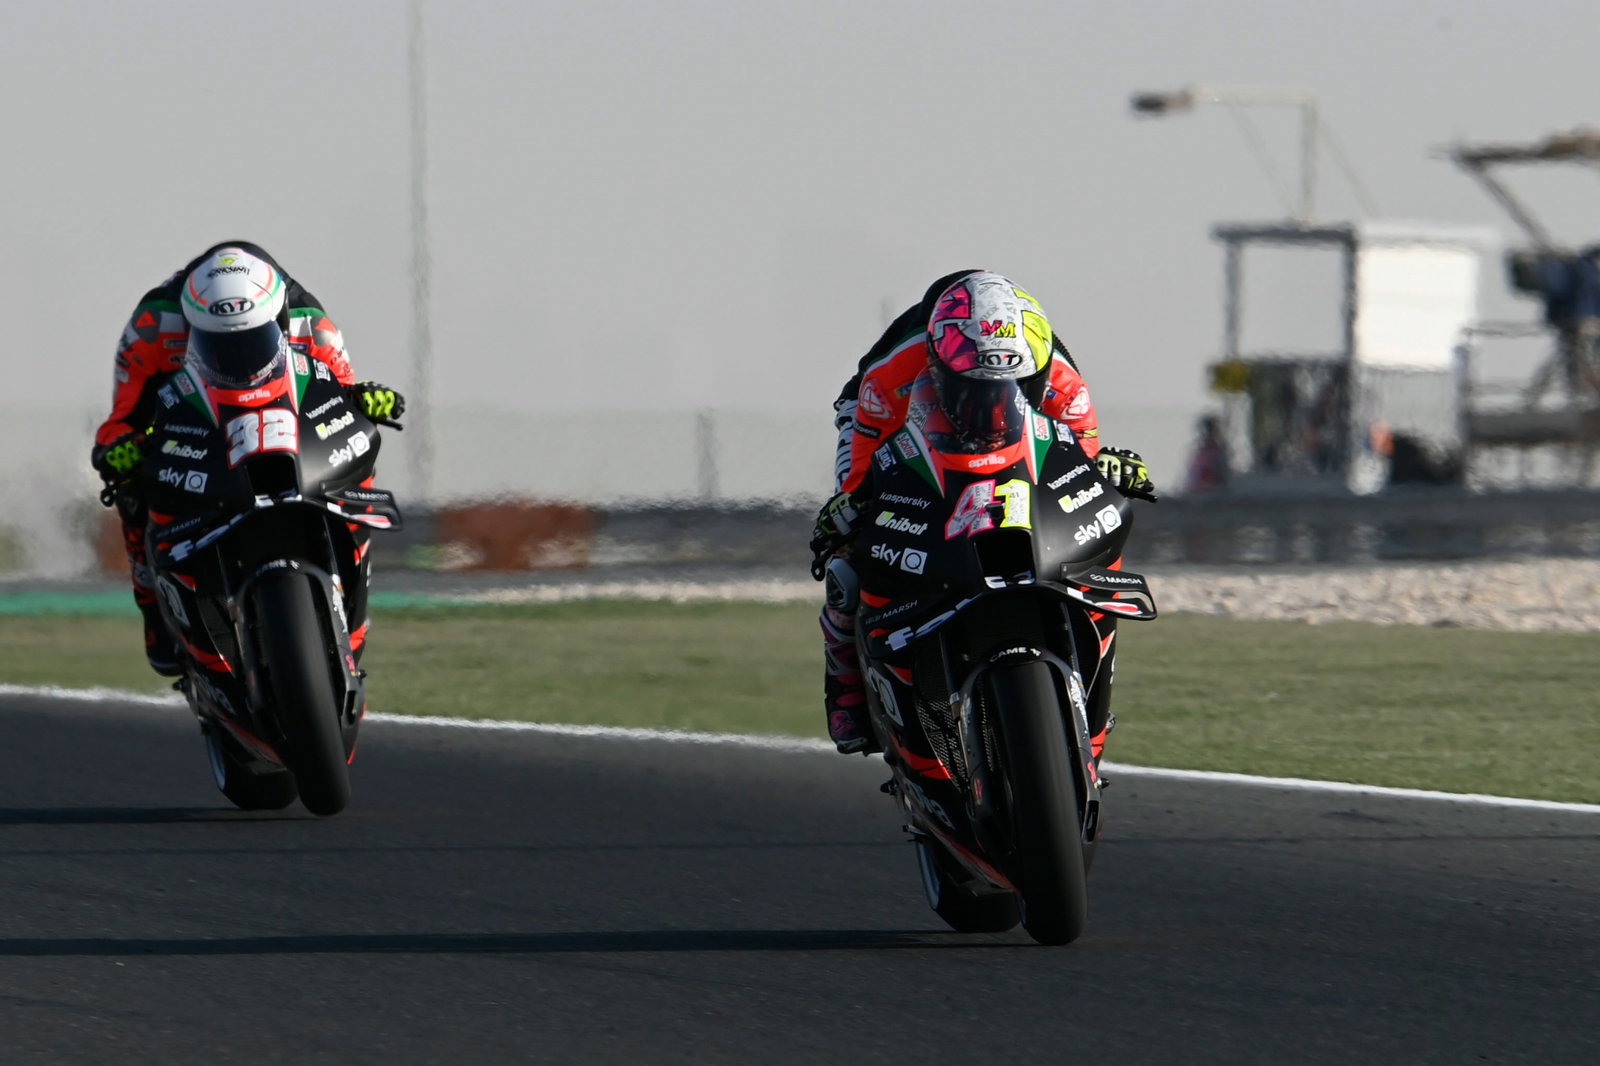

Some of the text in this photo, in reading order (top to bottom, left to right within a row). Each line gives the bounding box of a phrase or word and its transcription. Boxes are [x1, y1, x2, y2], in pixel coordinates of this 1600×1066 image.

[211, 300, 248, 314] KYT
[238, 389, 271, 402] aprilia
[305, 395, 344, 419] kaspersky
[163, 423, 210, 438] kaspersky
[315, 410, 355, 440] Unibat
[225, 407, 298, 469] 32
[161, 439, 209, 460] Unibat
[328, 445, 353, 467] sky
[968, 454, 1007, 468] aprilia
[158, 467, 185, 488] sky
[1047, 463, 1091, 490] kaspersky
[879, 491, 932, 510] kaspersky
[1058, 481, 1104, 513] Unibat
[945, 479, 1032, 540] 41
[875, 510, 929, 536] Unibat
[1073, 519, 1101, 546] sky
[870, 543, 901, 566] sky
[1106, 576, 1143, 585] MARSH
[882, 599, 918, 620] MARSH
